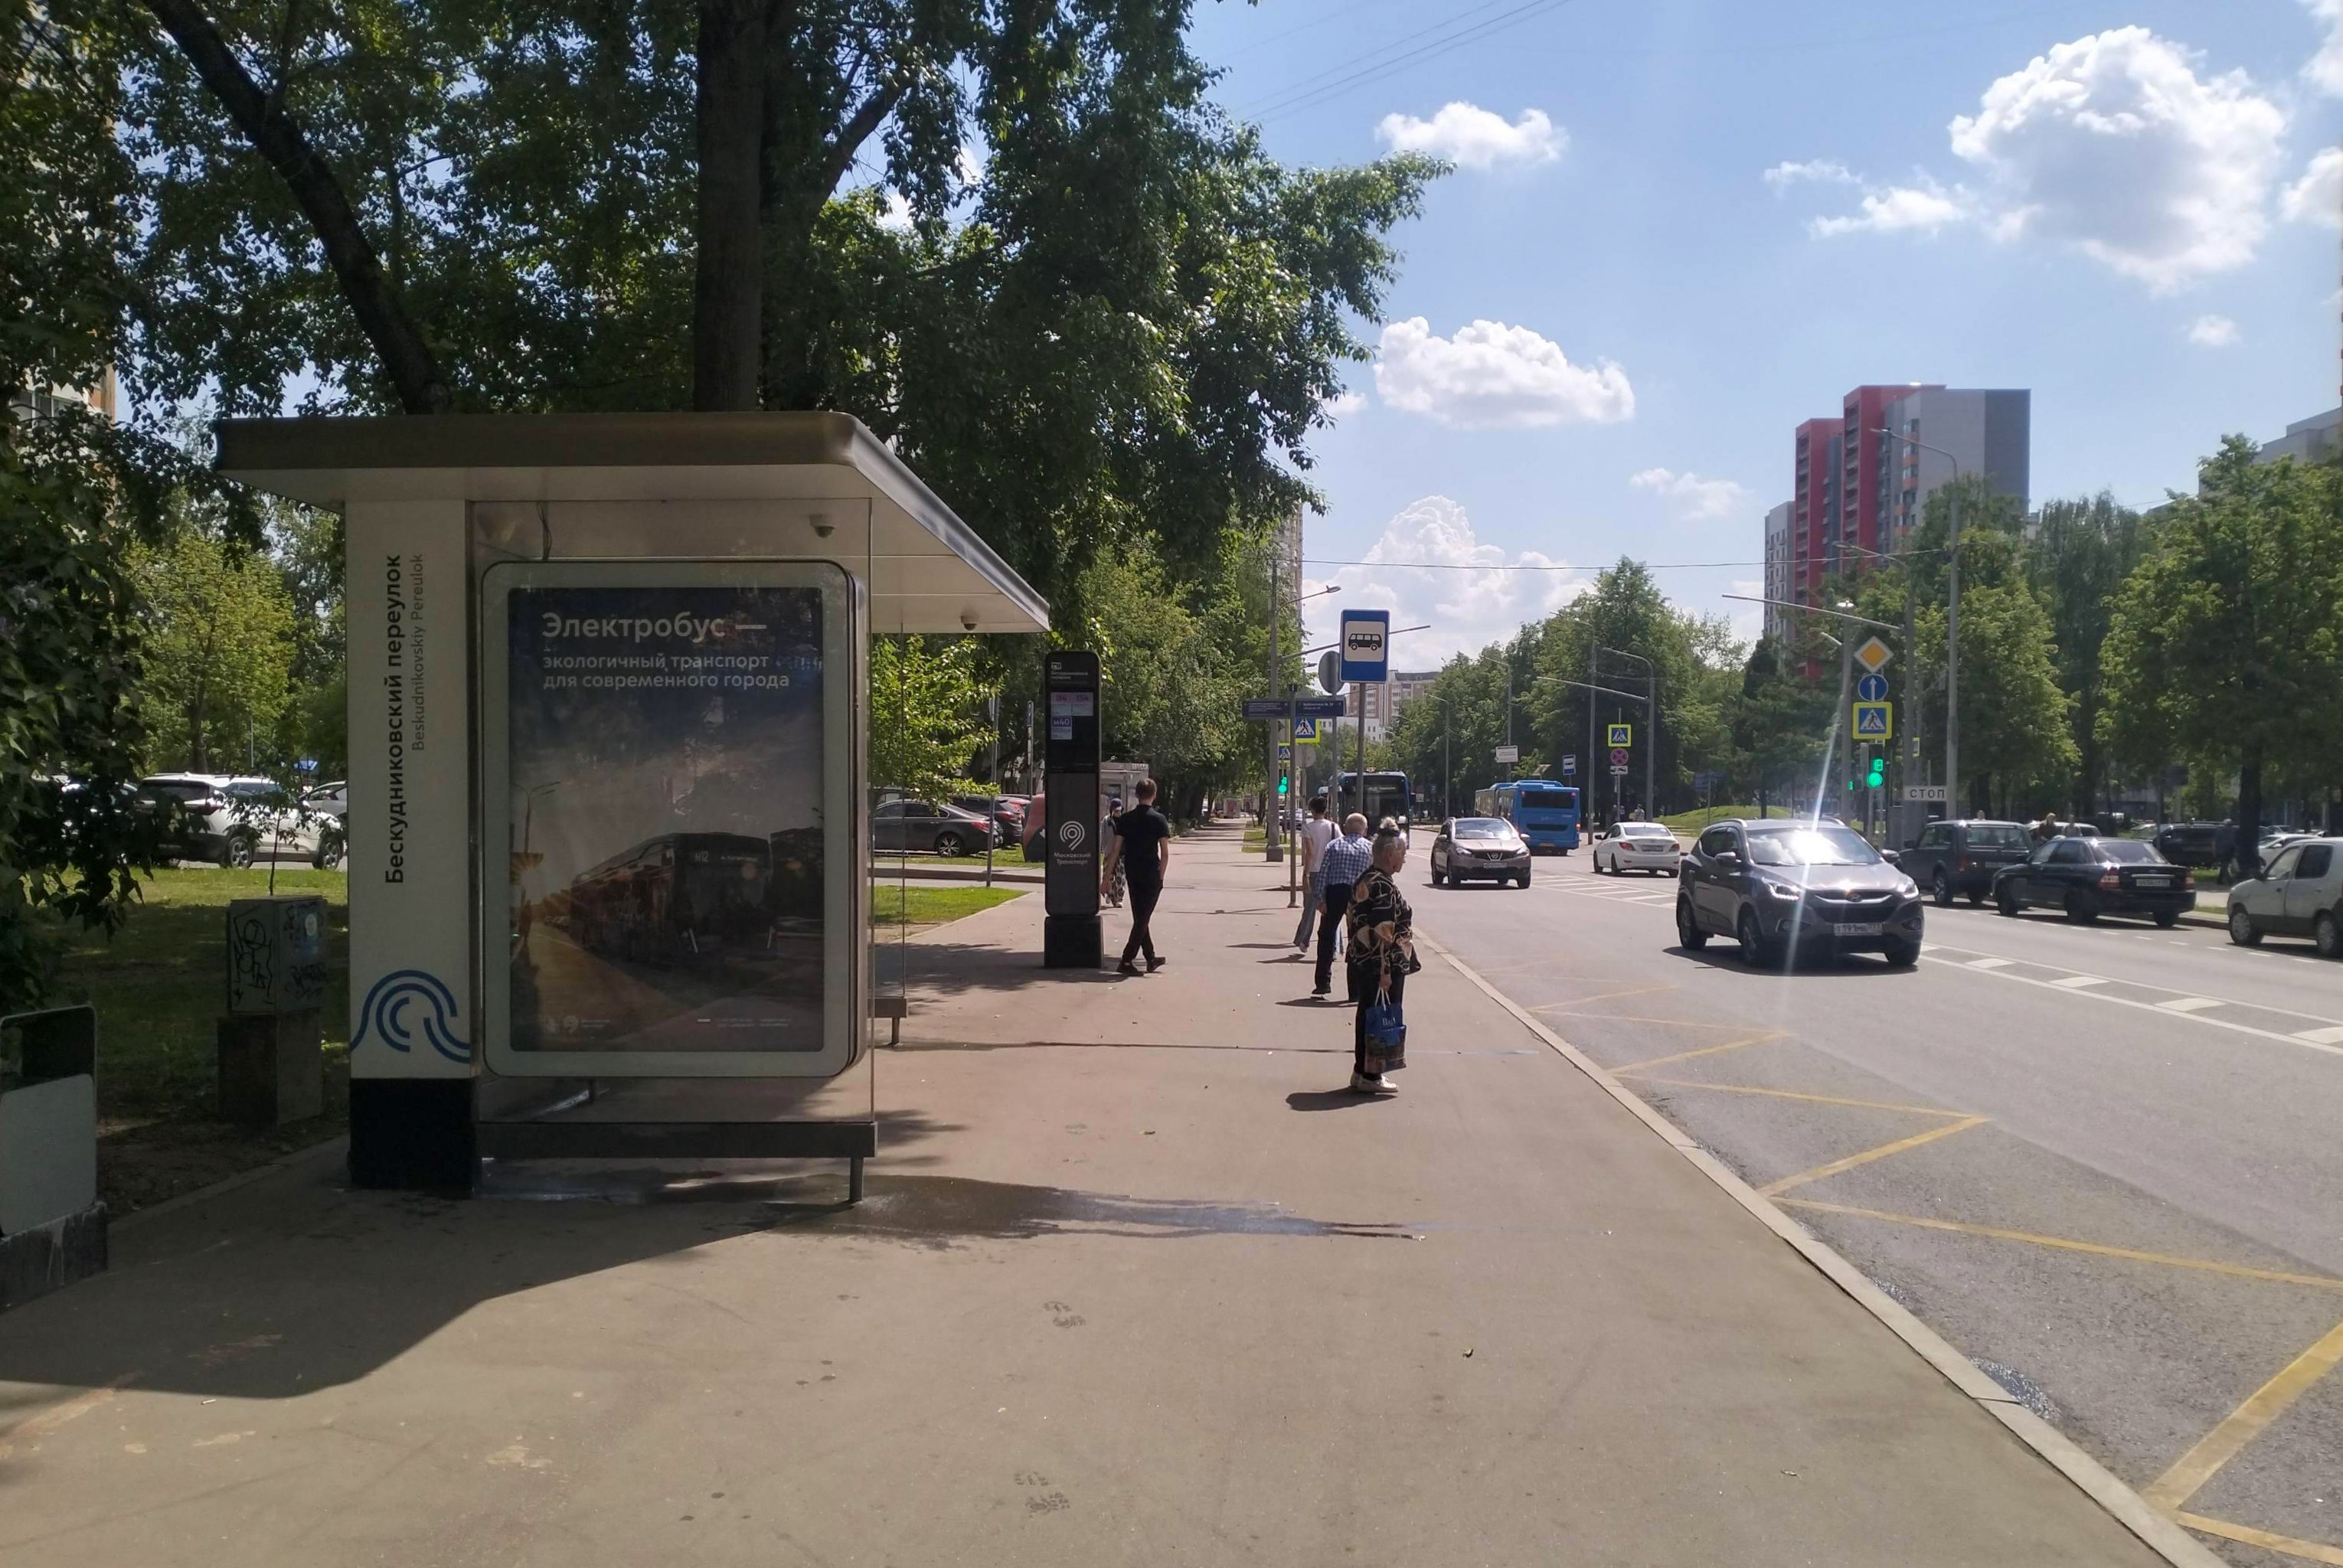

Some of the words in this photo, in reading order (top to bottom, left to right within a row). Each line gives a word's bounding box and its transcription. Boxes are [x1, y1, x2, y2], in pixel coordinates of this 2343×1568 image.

[387, 555, 406, 667] переулок
[409, 554, 423, 620] Pereulok
[541, 611, 726, 643] Электробус
[543, 652, 666, 668] экологичный
[671, 655, 769, 671] транспорт
[544, 675, 577, 690] для
[583, 675, 718, 691] современного
[724, 675, 789, 691] города
[411, 626, 426, 750] Beskudnikovskiy
[384, 675, 408, 884] Бескудниковский
[1910, 789, 1945, 799] СТОП
